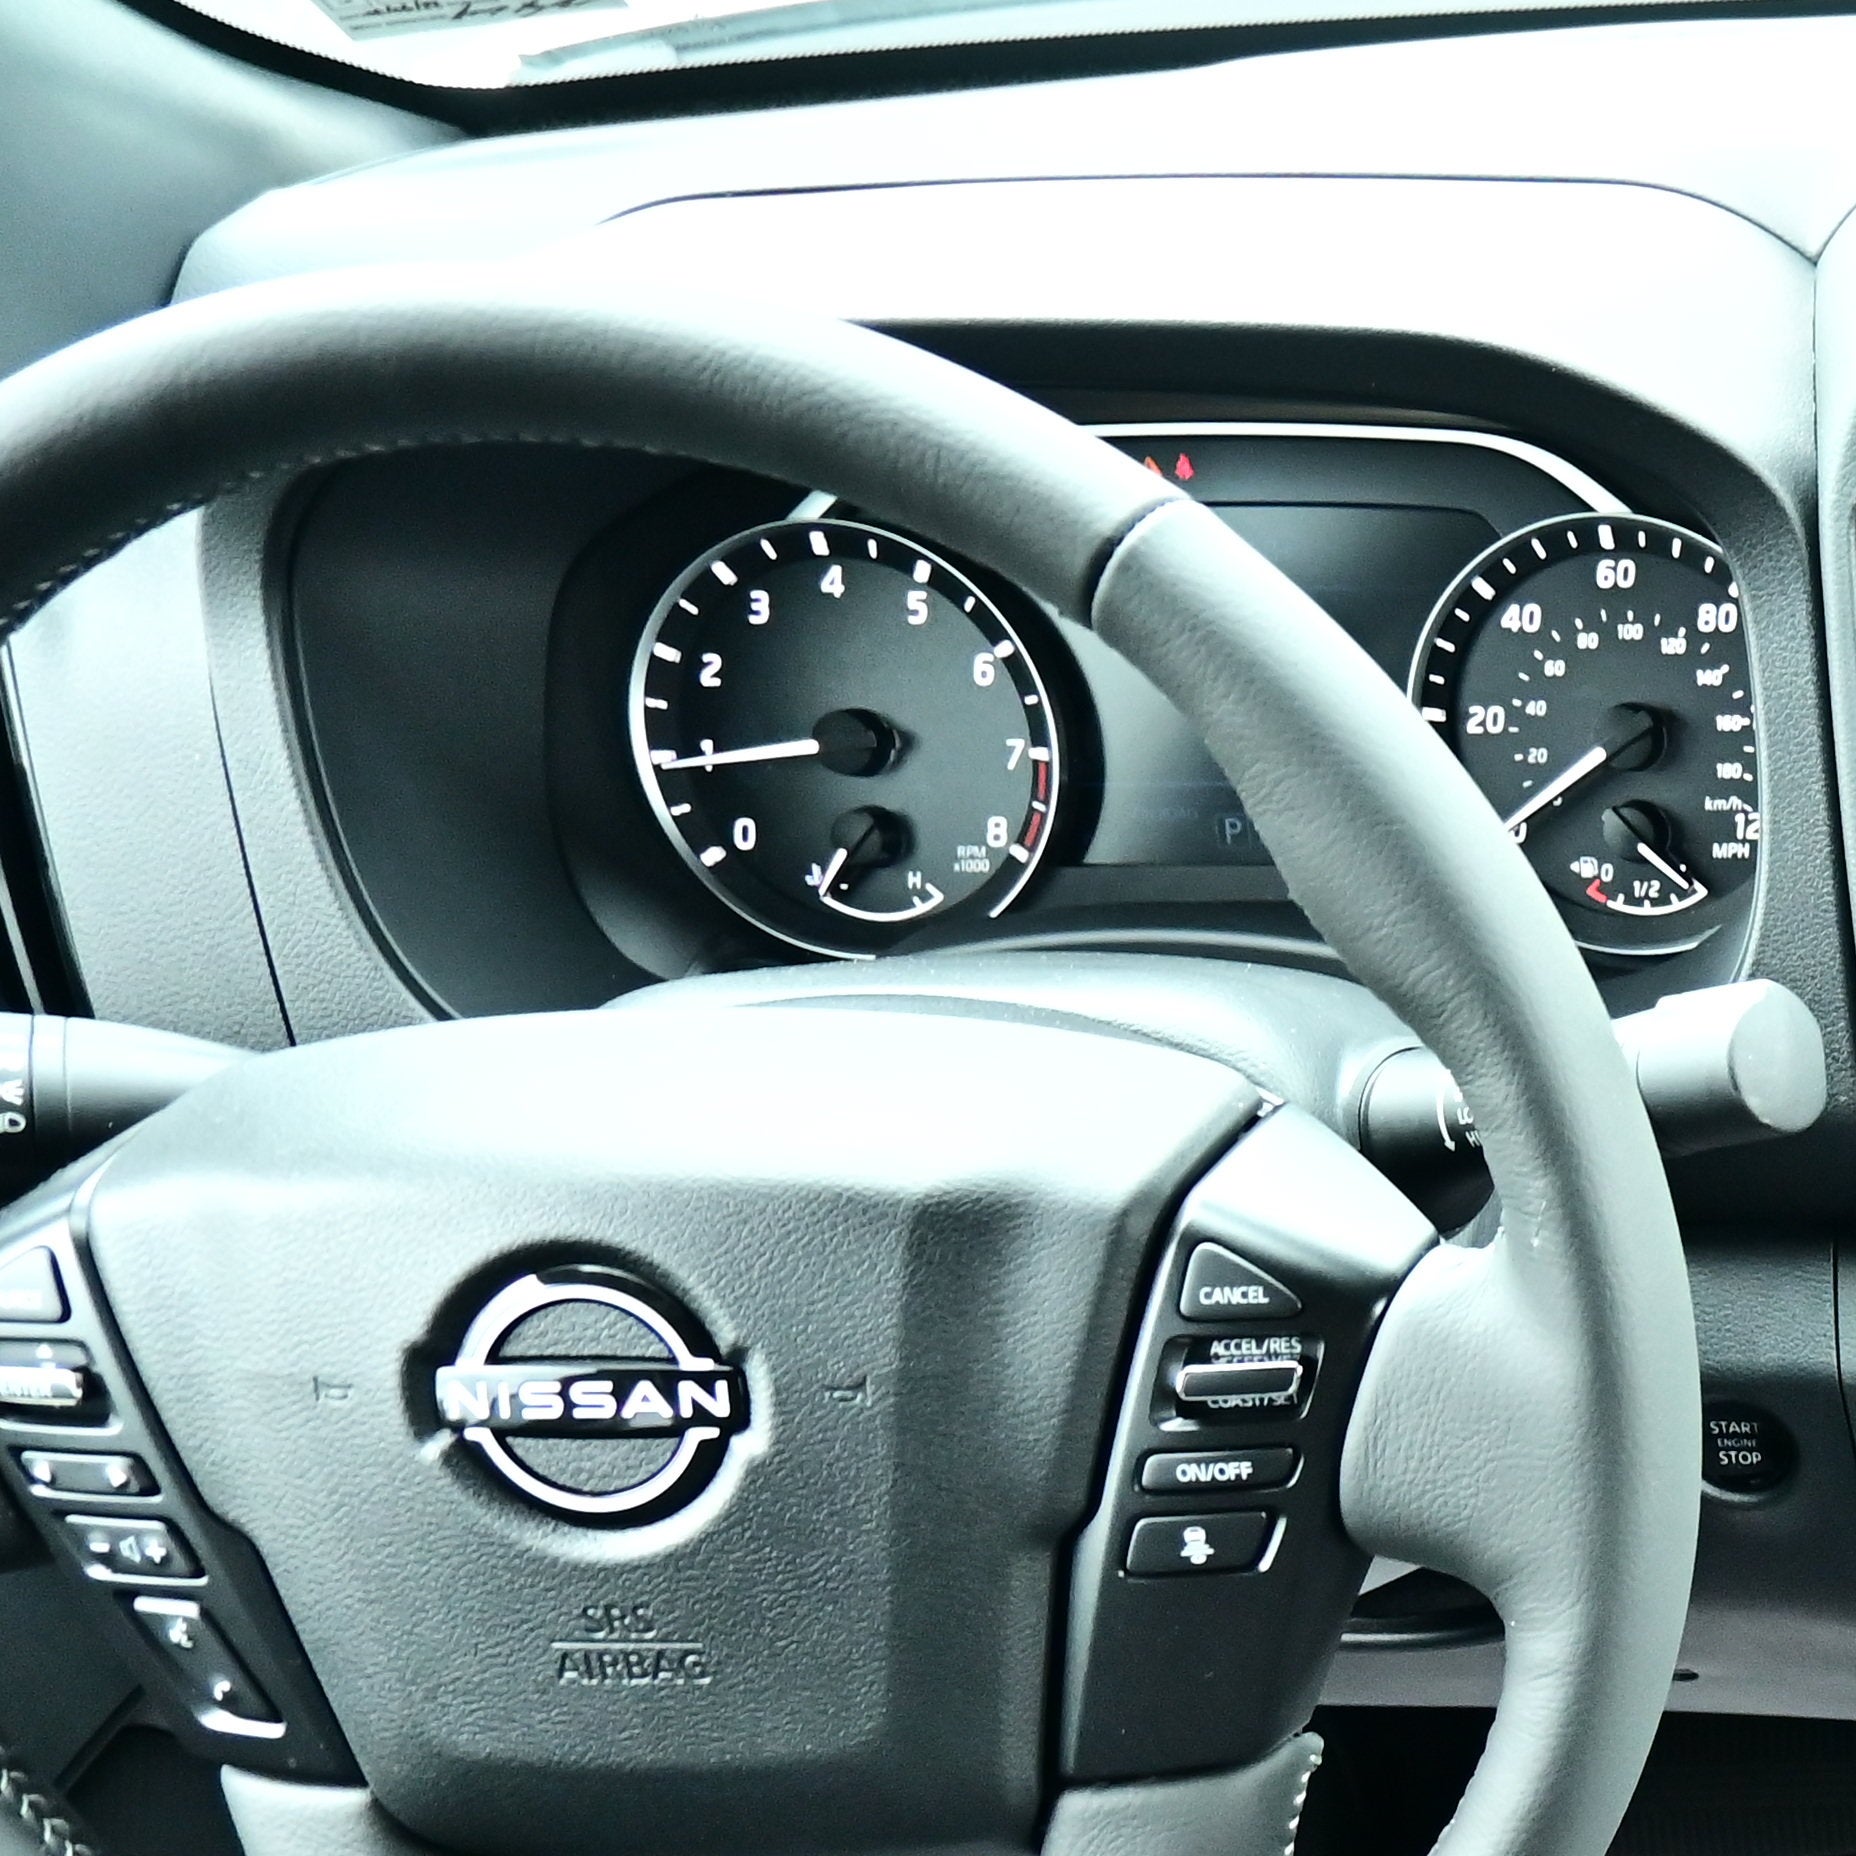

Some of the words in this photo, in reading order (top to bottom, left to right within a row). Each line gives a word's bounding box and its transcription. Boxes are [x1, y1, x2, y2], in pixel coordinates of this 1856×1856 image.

[821, 564, 845, 597] 4
[1596, 559, 1636, 588] 60
[748, 590, 770, 625] 3
[906, 590, 928, 625] 5
[1500, 604, 1542, 632] 40
[1697, 603, 1738, 632] 80
[1617, 624, 1644, 641] 100
[1660, 637, 1687, 655] 120
[700, 653, 722, 687] 2
[973, 652, 995, 686] 6
[1543, 659, 1566, 677] 60
[1697, 669, 1723, 686] 140
[1467, 705, 1506, 734] 20
[1525, 700, 1547, 717] 40
[1005, 738, 1026, 770] 7
[1527, 747, 1548, 763] 20
[1704, 796, 1743, 813] km/h
[733, 818, 756, 850] 0
[986, 817, 1008, 848] 8
[1225, 818, 1242, 845] P
[1735, 812, 1759, 840] 12
[957, 847, 987, 860] RPM
[1712, 842, 1750, 860] MPH
[908, 873, 921, 888] H
[1600, 863, 1614, 883] 0
[1633, 878, 1660, 899] 1/2
[1200, 1286, 1269, 1306] CANCEL
[1210, 1337, 1302, 1356] ACCEL/RES
[443, 1379, 731, 1420] NISSAN
[1709, 1420, 1761, 1435] START
[1717, 1437, 1757, 1449] ENGINE
[1717, 1449, 1763, 1466] STOP
[1176, 1461, 1253, 1483] ON/OFF
[581, 1605, 656, 1638] SRS
[556, 1652, 712, 1686] AIRBAG
